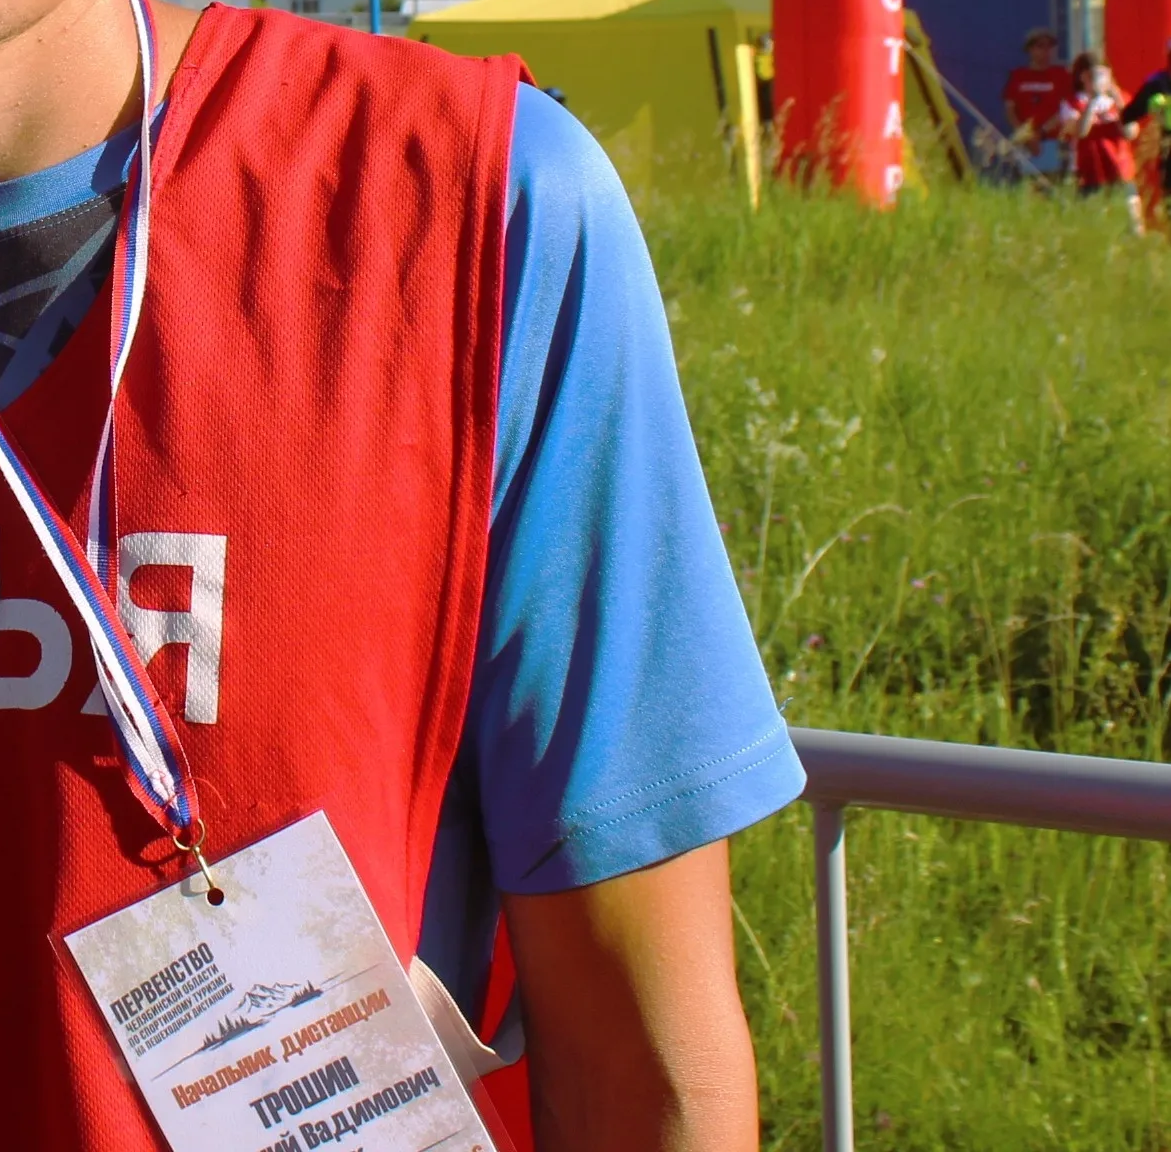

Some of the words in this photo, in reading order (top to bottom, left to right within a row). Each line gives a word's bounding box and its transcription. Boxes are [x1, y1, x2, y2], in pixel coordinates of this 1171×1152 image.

[110, 942, 214, 1025] ПЕРВЕНСТВО
[125, 986, 184, 1033] ЧЕЛЯБИНСКОЙ
[181, 963, 219, 995] ОБЛАСТИ
[128, 1035, 141, 1047] ПО
[139, 998, 193, 1040] СПОРТИВНОМУ
[192, 973, 227, 1003] ТУРИЗМУ
[134, 1044, 147, 1057] НА
[144, 1012, 193, 1050] ПЕШЕХОДНЫХ
[192, 983, 234, 1019] ДИСТАНЦИЯХ
[171, 1046, 277, 1110] Начальник
[280, 988, 391, 1062] дистанции
[249, 1056, 361, 1129] ТРОШИН
[298, 1066, 442, 1150] Вадимович
